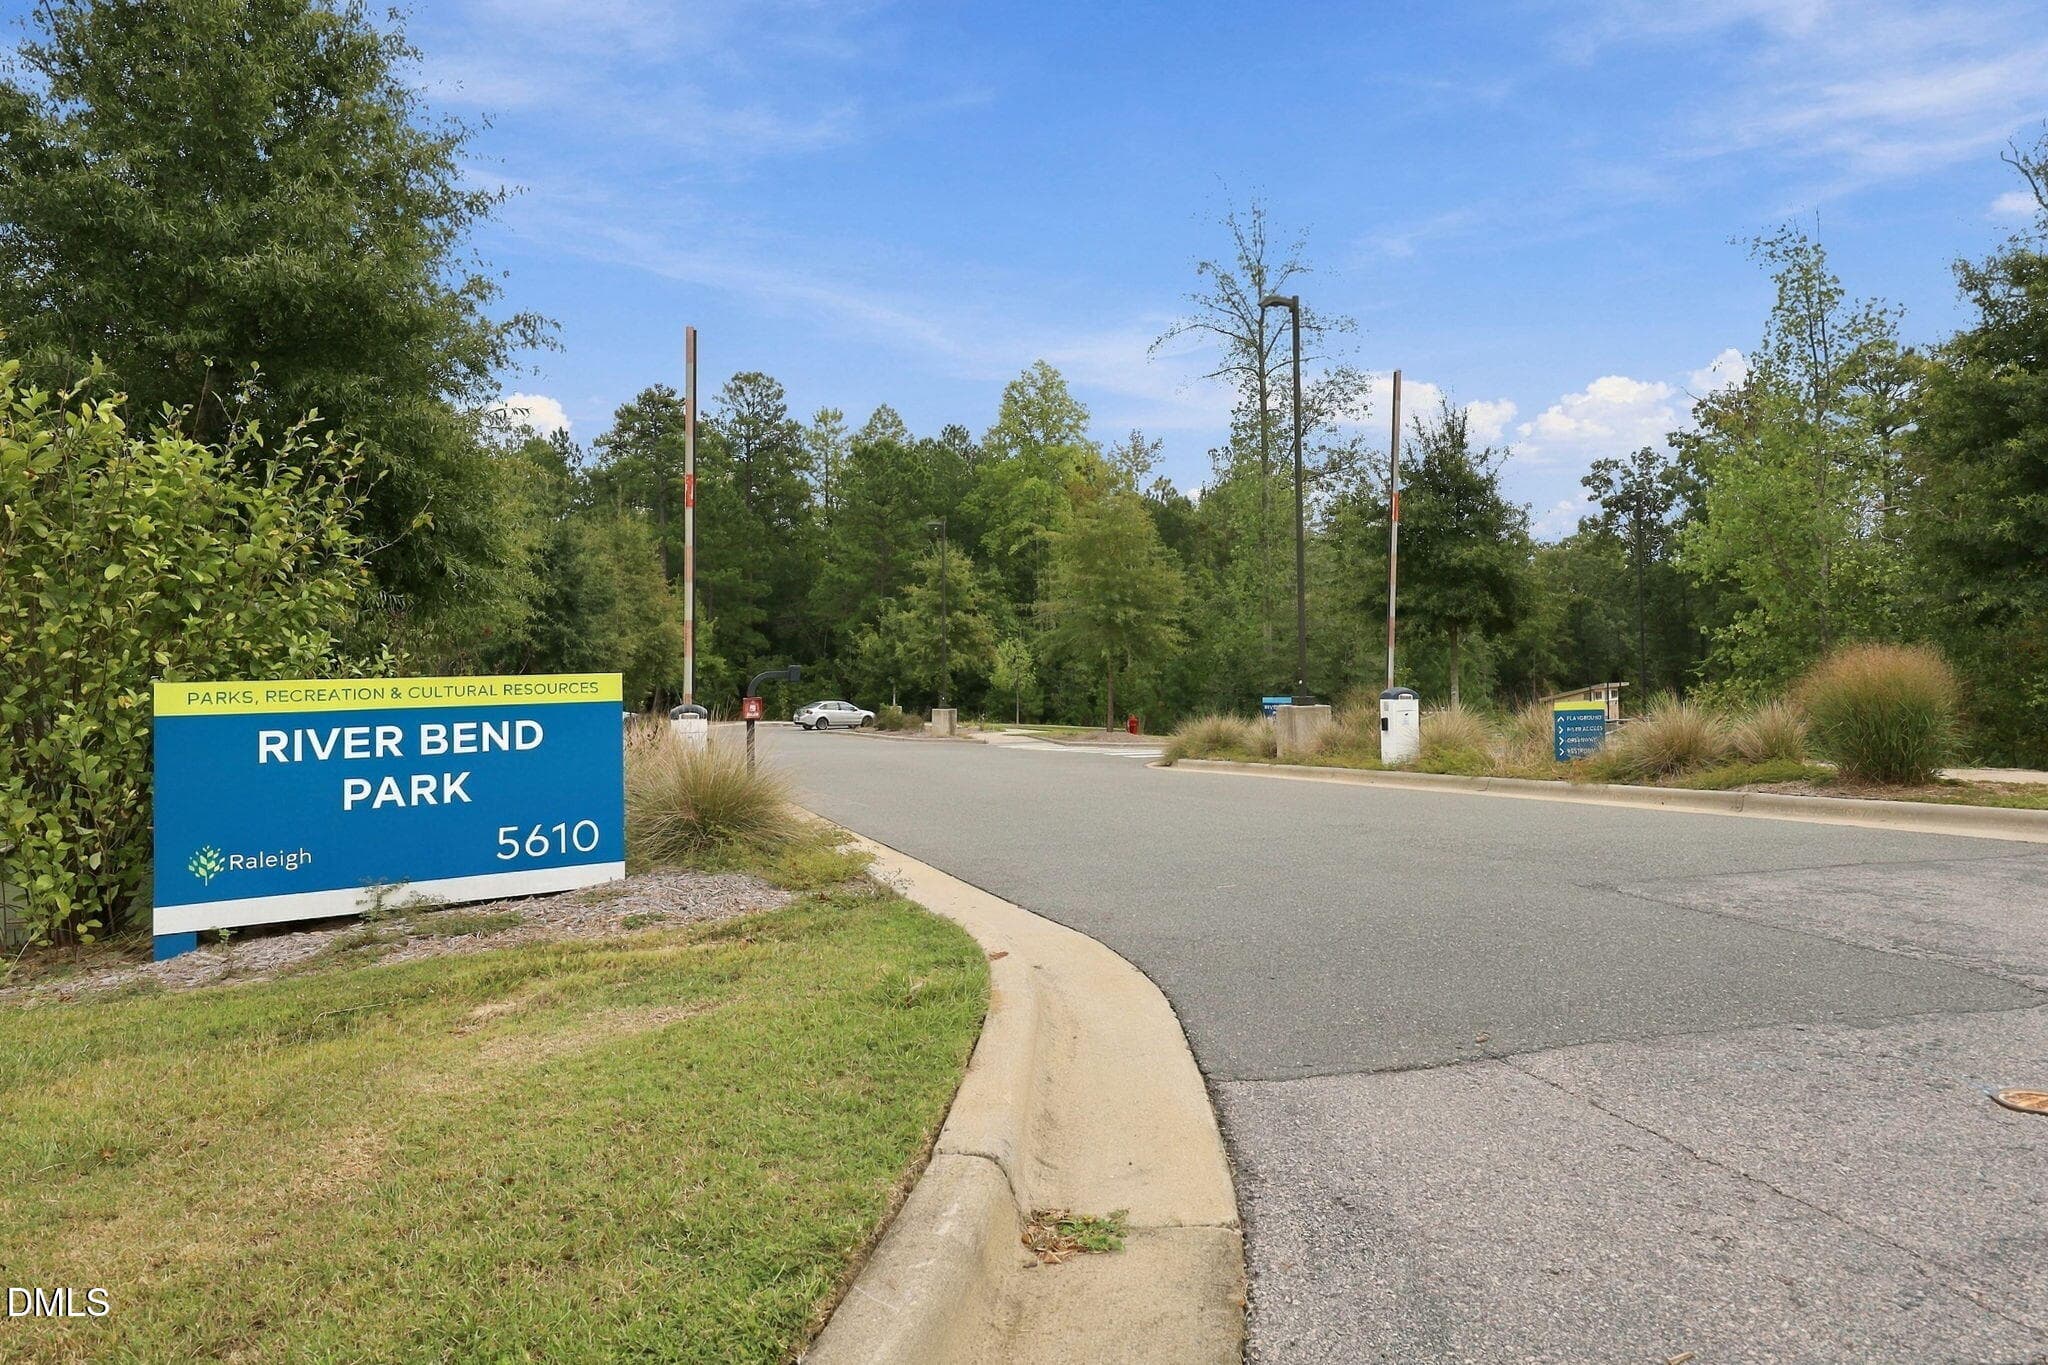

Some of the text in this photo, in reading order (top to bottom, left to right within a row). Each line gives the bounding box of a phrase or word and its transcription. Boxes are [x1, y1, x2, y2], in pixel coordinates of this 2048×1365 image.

[187, 681, 599, 706] PARKS, RECREATION & CULTURAL RESOURCES
[258, 719, 544, 764] RIVER BEND
[343, 771, 473, 811] PARK
[229, 847, 313, 872] Raleigh
[496, 819, 600, 861] 5610
